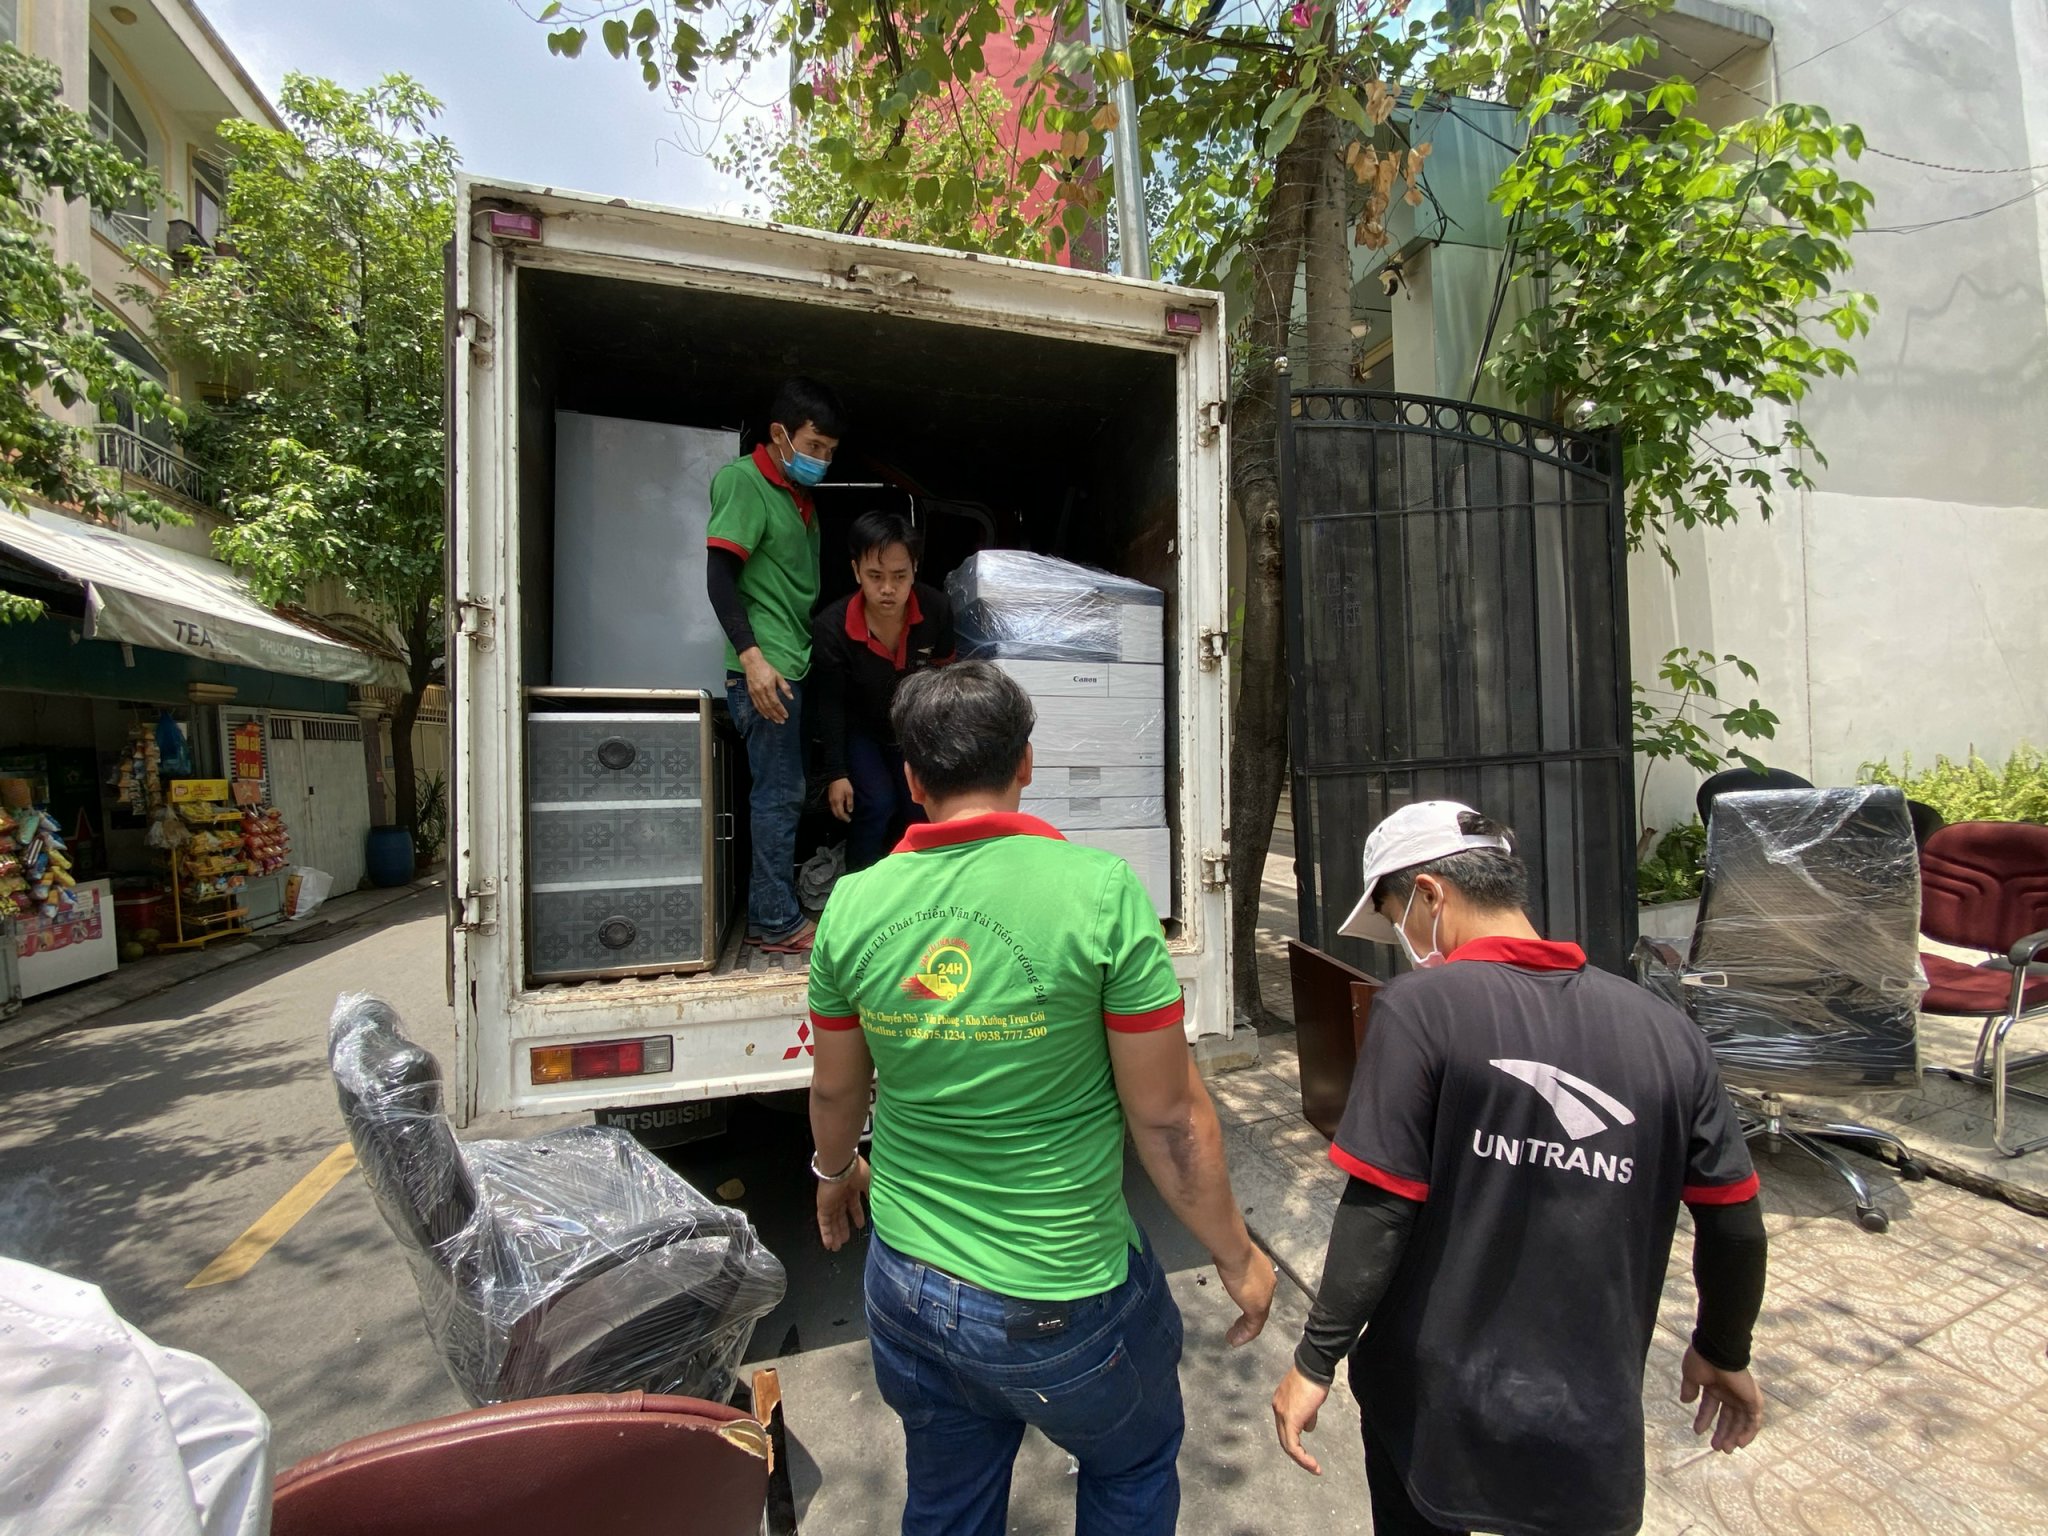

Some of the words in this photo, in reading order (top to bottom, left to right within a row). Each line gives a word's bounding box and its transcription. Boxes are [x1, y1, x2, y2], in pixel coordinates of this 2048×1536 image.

[173, 619, 215, 649] TEA
[1073, 675, 1097, 684] Canon
[856, 949, 874, 981] TNHH
[872, 932, 888, 950] TM
[888, 917, 915, 936] Phát
[915, 905, 946, 922] Triển
[950, 906, 970, 921] Vận
[973, 911, 991, 928] Tải
[992, 921, 1013, 946] Tiến
[1012, 945, 1040, 984] Cường
[937, 962, 963, 975] 24H
[965, 1014, 980, 1025] Kho
[1008, 1014, 1029, 1026] Trọn
[1030, 1010, 1045, 1022] Gói
[867, 1022, 897, 1037] Hotline
[905, 1028, 966, 1040] 035.675.1234
[975, 1026, 1047, 1041] 0938.777.300
[607, 1101, 711, 1130] MITSUBISHI
[1472, 1128, 1634, 1184] UNITRANS
